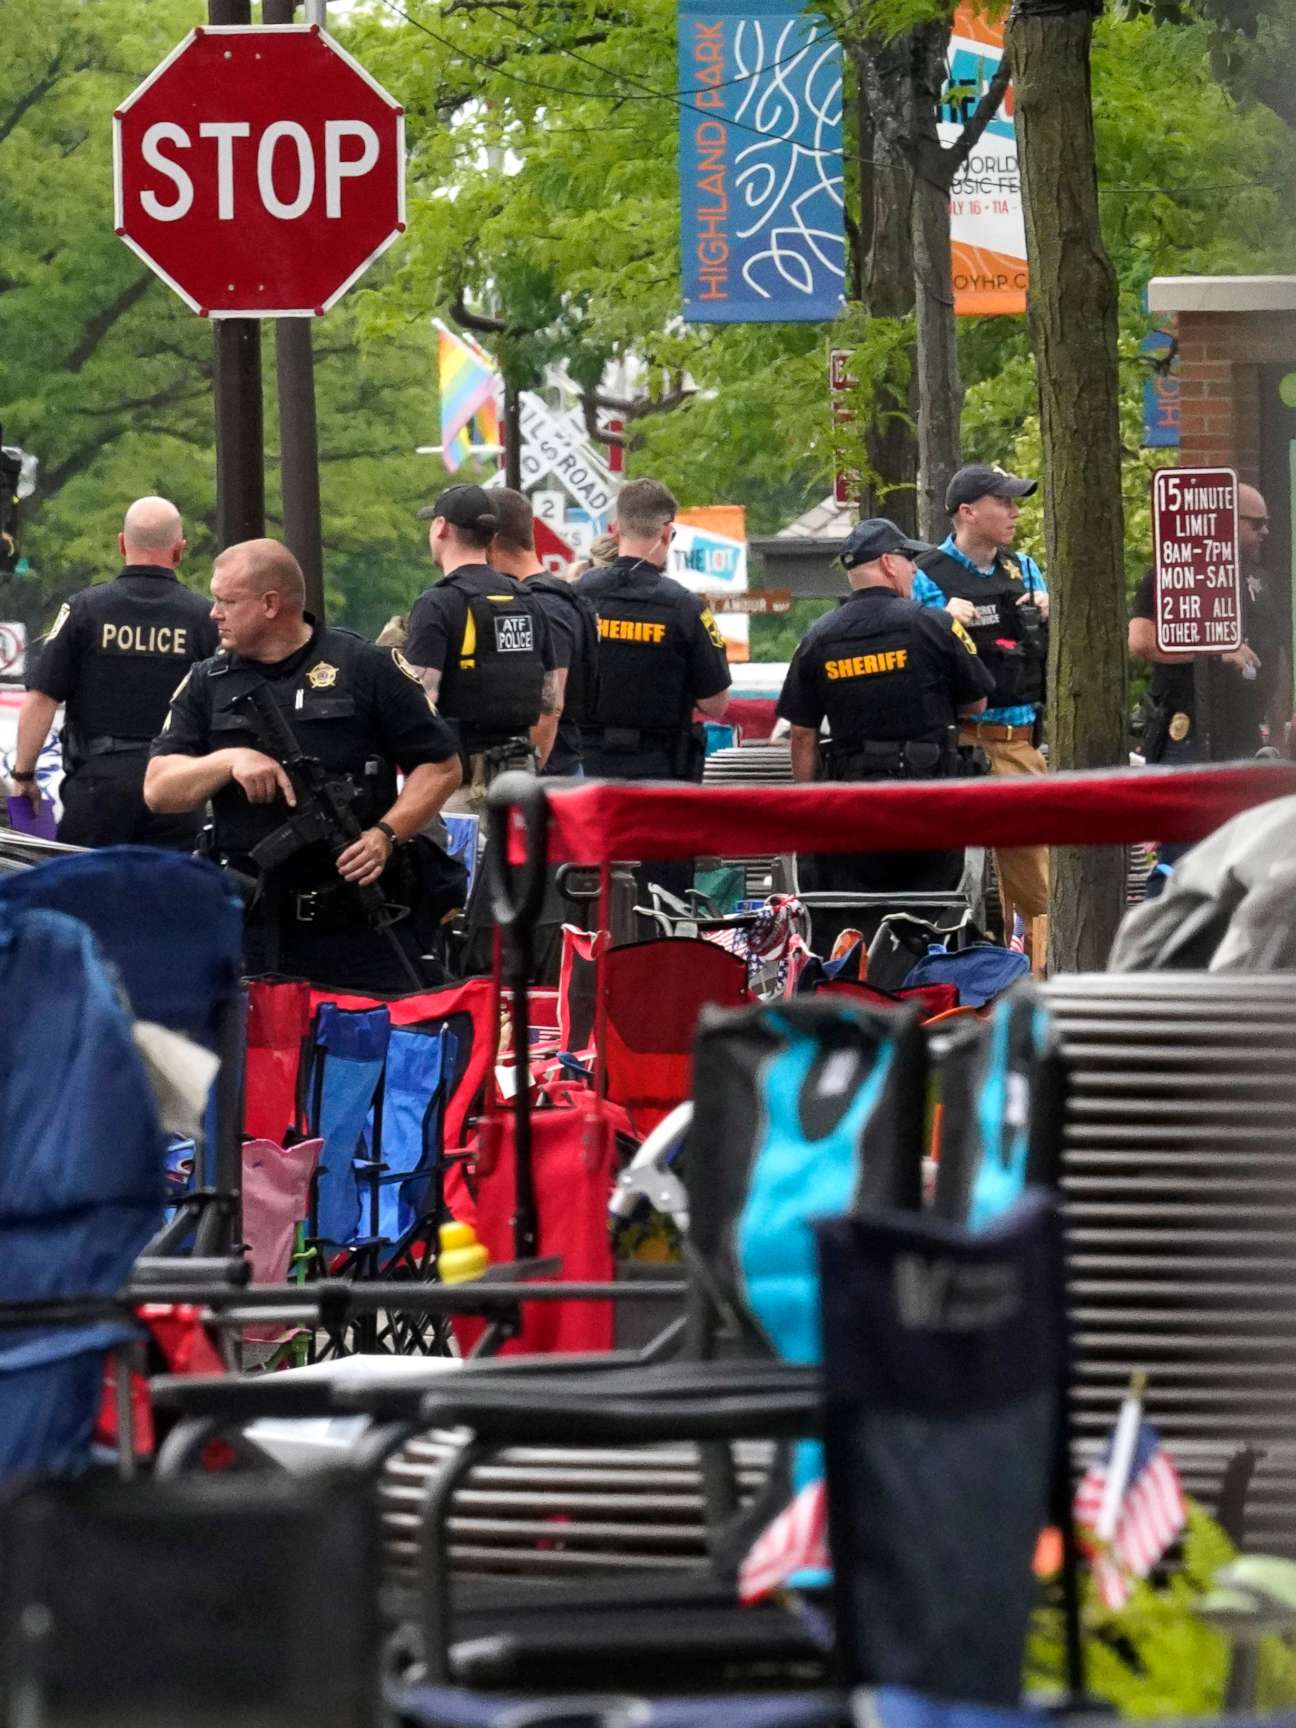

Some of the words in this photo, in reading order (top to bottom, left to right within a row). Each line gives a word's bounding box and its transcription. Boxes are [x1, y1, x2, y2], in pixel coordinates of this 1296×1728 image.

[694, 20, 725, 108] PARK
[140, 119, 380, 222] STOP
[951, 177, 993, 195] USIC
[998, 177, 1019, 194] FE
[695, 121, 728, 300] HIGHLAND
[969, 201, 982, 215] 16
[557, 455, 608, 510] ROAD
[1159, 478, 1182, 511] 15
[1184, 487, 1233, 511] MINUTE
[541, 500, 555, 519] 2
[1176, 513, 1217, 537] LIMIT
[1163, 596, 1174, 619] 2
[1179, 595, 1201, 619] HR
[1212, 597, 1235, 618] ALL
[503, 618, 526, 632] ATF
[597, 618, 666, 644] HERIFF
[1162, 622, 1200, 643] OTHER
[1204, 621, 1238, 642] TIMES
[102, 623, 187, 654] POLICE
[499, 631, 532, 649] POLICE
[825, 649, 908, 681] SHERIFF
